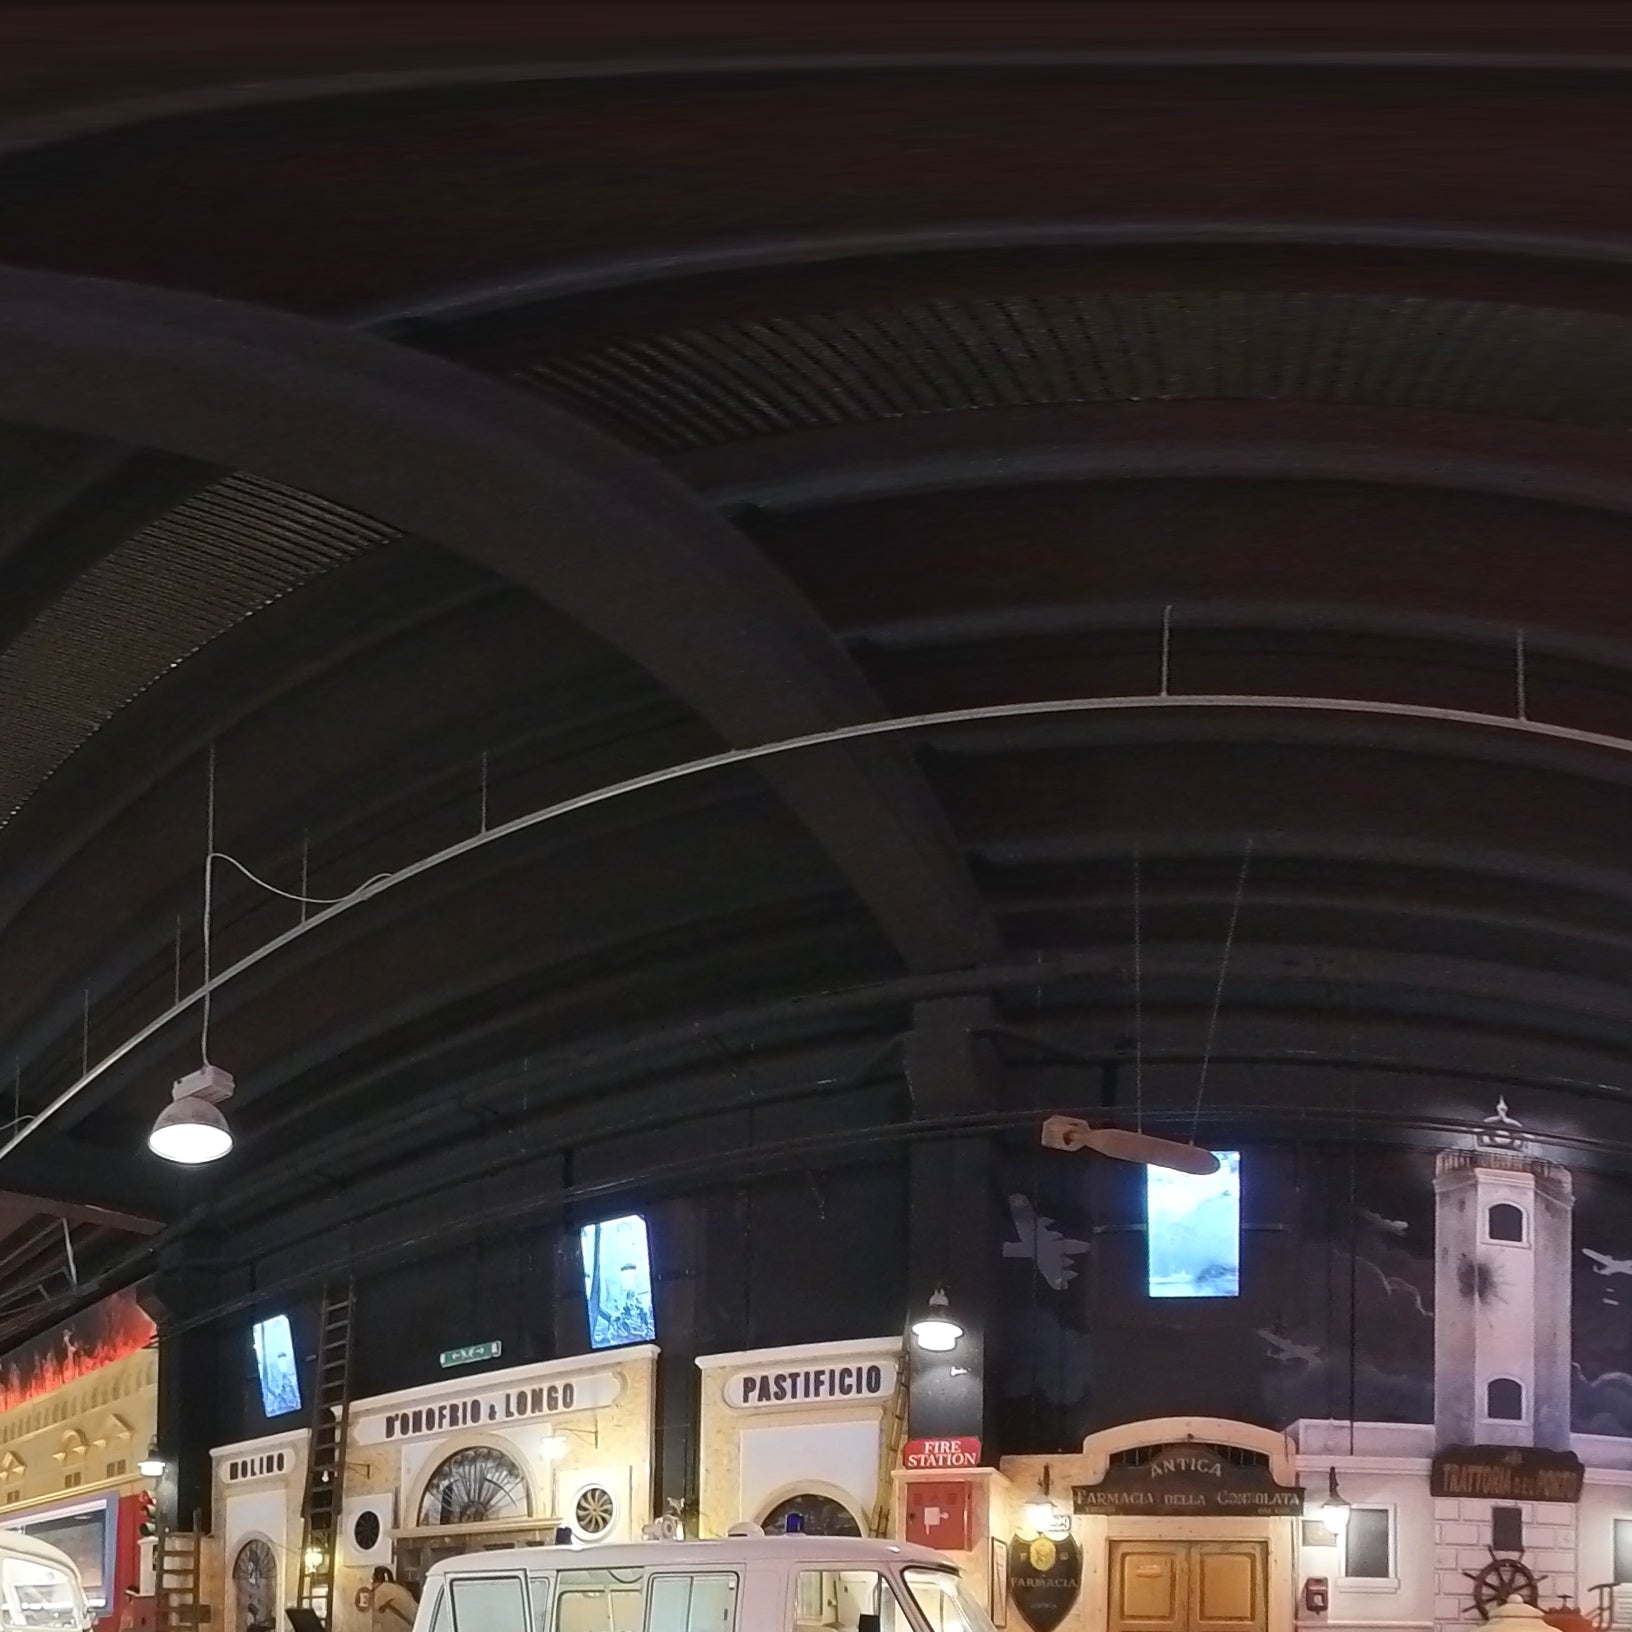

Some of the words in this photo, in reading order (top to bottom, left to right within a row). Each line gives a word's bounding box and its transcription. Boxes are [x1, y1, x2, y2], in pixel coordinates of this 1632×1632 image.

[743, 1365, 882, 1403] PASTIFICIO
[385, 1400, 482, 1439] D'ONOFRIO
[505, 1383, 575, 1418] LONGO
[925, 1440, 962, 1454] FIRE
[229, 1452, 285, 1481] MOLINO
[907, 1453, 977, 1467] STATION
[1150, 1458, 1222, 1478] ANTICA
[1443, 1464, 1512, 1494] TRATTORIA
[1076, 1489, 1154, 1505] FARMACIA
[1164, 1494, 1207, 1505] DELLA
[1011, 1577, 1078, 1588] FARMACIA
